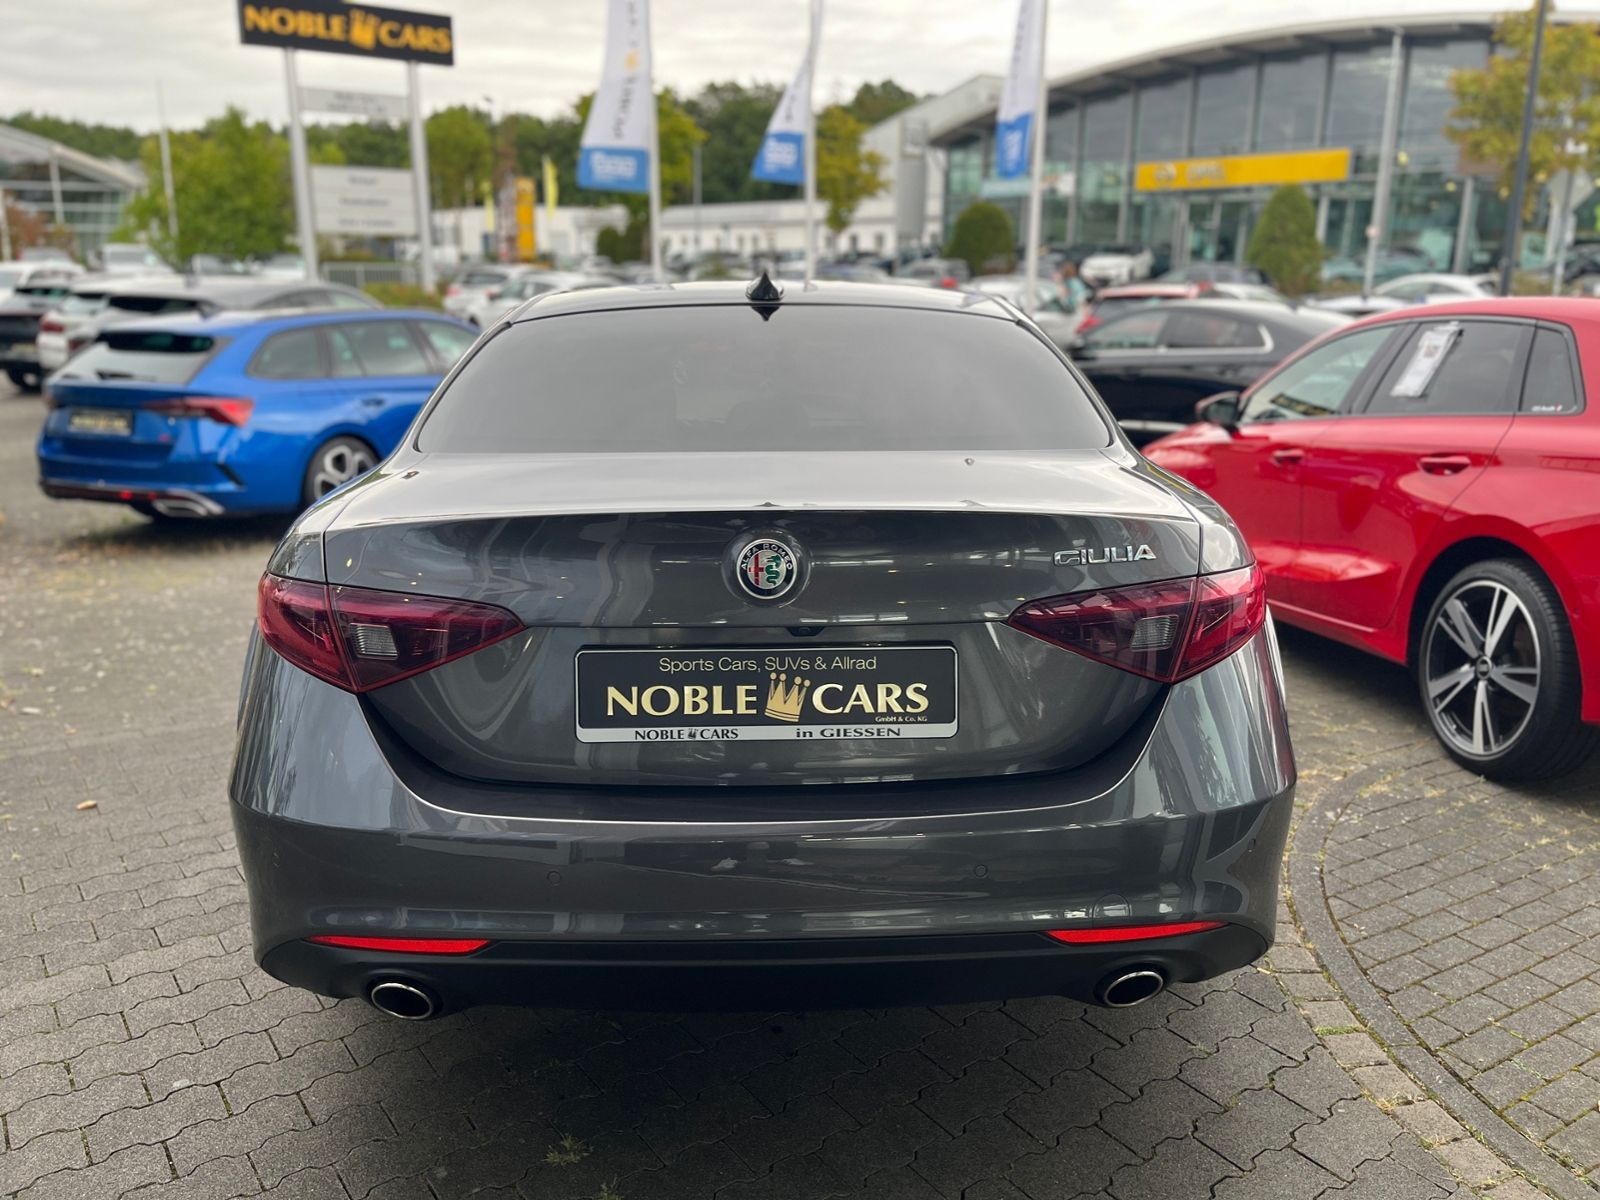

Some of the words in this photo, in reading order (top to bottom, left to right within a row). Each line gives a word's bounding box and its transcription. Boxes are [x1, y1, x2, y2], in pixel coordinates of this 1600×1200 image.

[243, 4, 348, 41] NOBLE
[378, 20, 452, 54] CARS
[741, 546, 759, 570] ALFA
[763, 543, 793, 570] ROMEO
[1054, 544, 1157, 565] GIULIA
[659, 657, 714, 674] Sports
[718, 656, 761, 673] Cars,
[764, 656, 811, 671] SUVs
[814, 656, 827, 670] &
[830, 656, 877, 671] Allrad
[607, 685, 757, 716] NOBLE
[812, 683, 929, 714] CARS
[635, 730, 684, 740] NOBLE
[700, 729, 739, 739] CARS
[796, 728, 814, 738] in
[820, 728, 901, 738] GIESSEN
